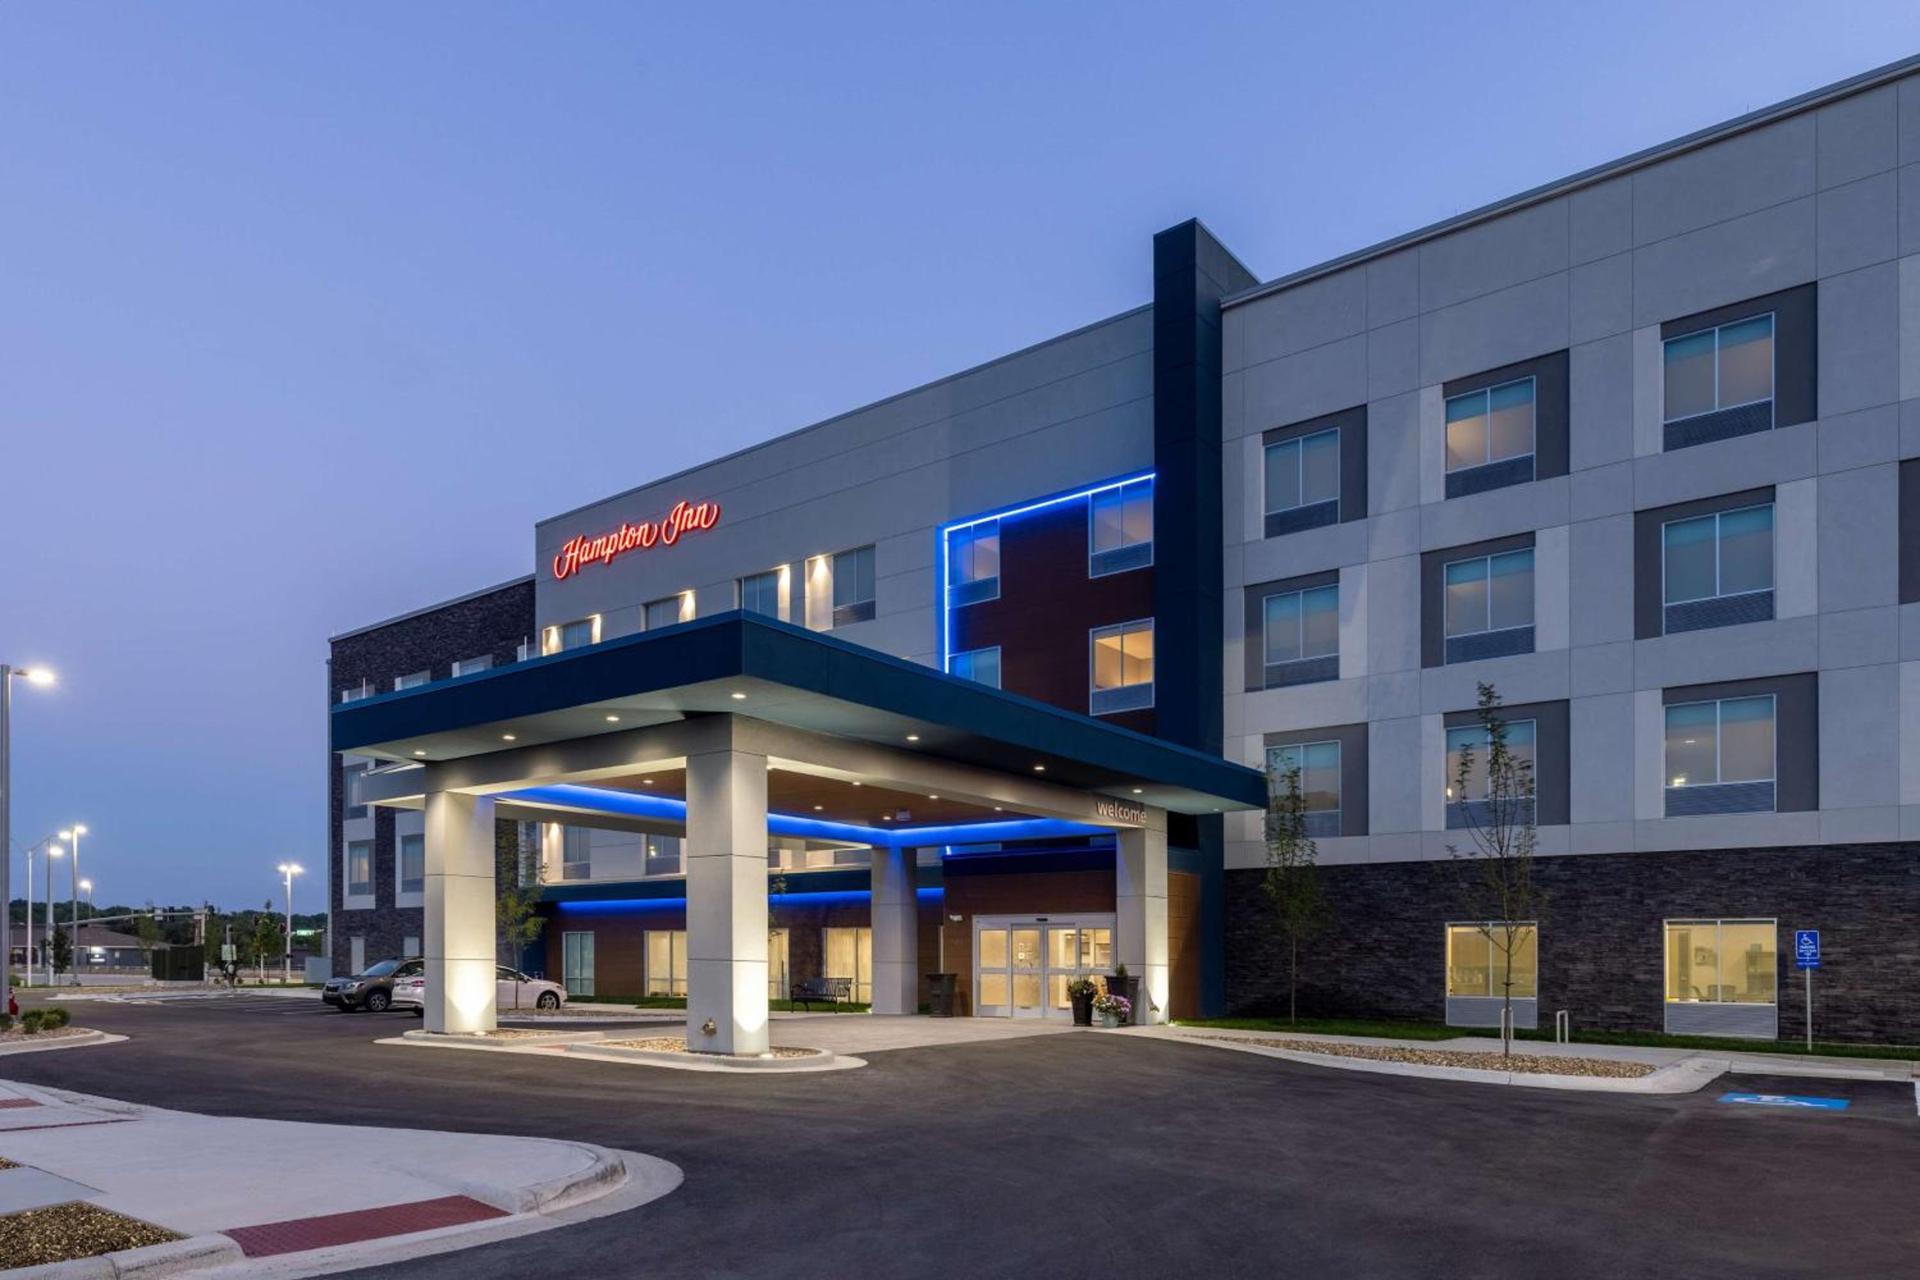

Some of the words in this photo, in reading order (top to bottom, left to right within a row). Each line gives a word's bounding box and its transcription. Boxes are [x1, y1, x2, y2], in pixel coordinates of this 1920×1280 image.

[554, 523, 661, 579] Hampton
[662, 501, 720, 546] Inn
[1096, 801, 1147, 823] welcome
